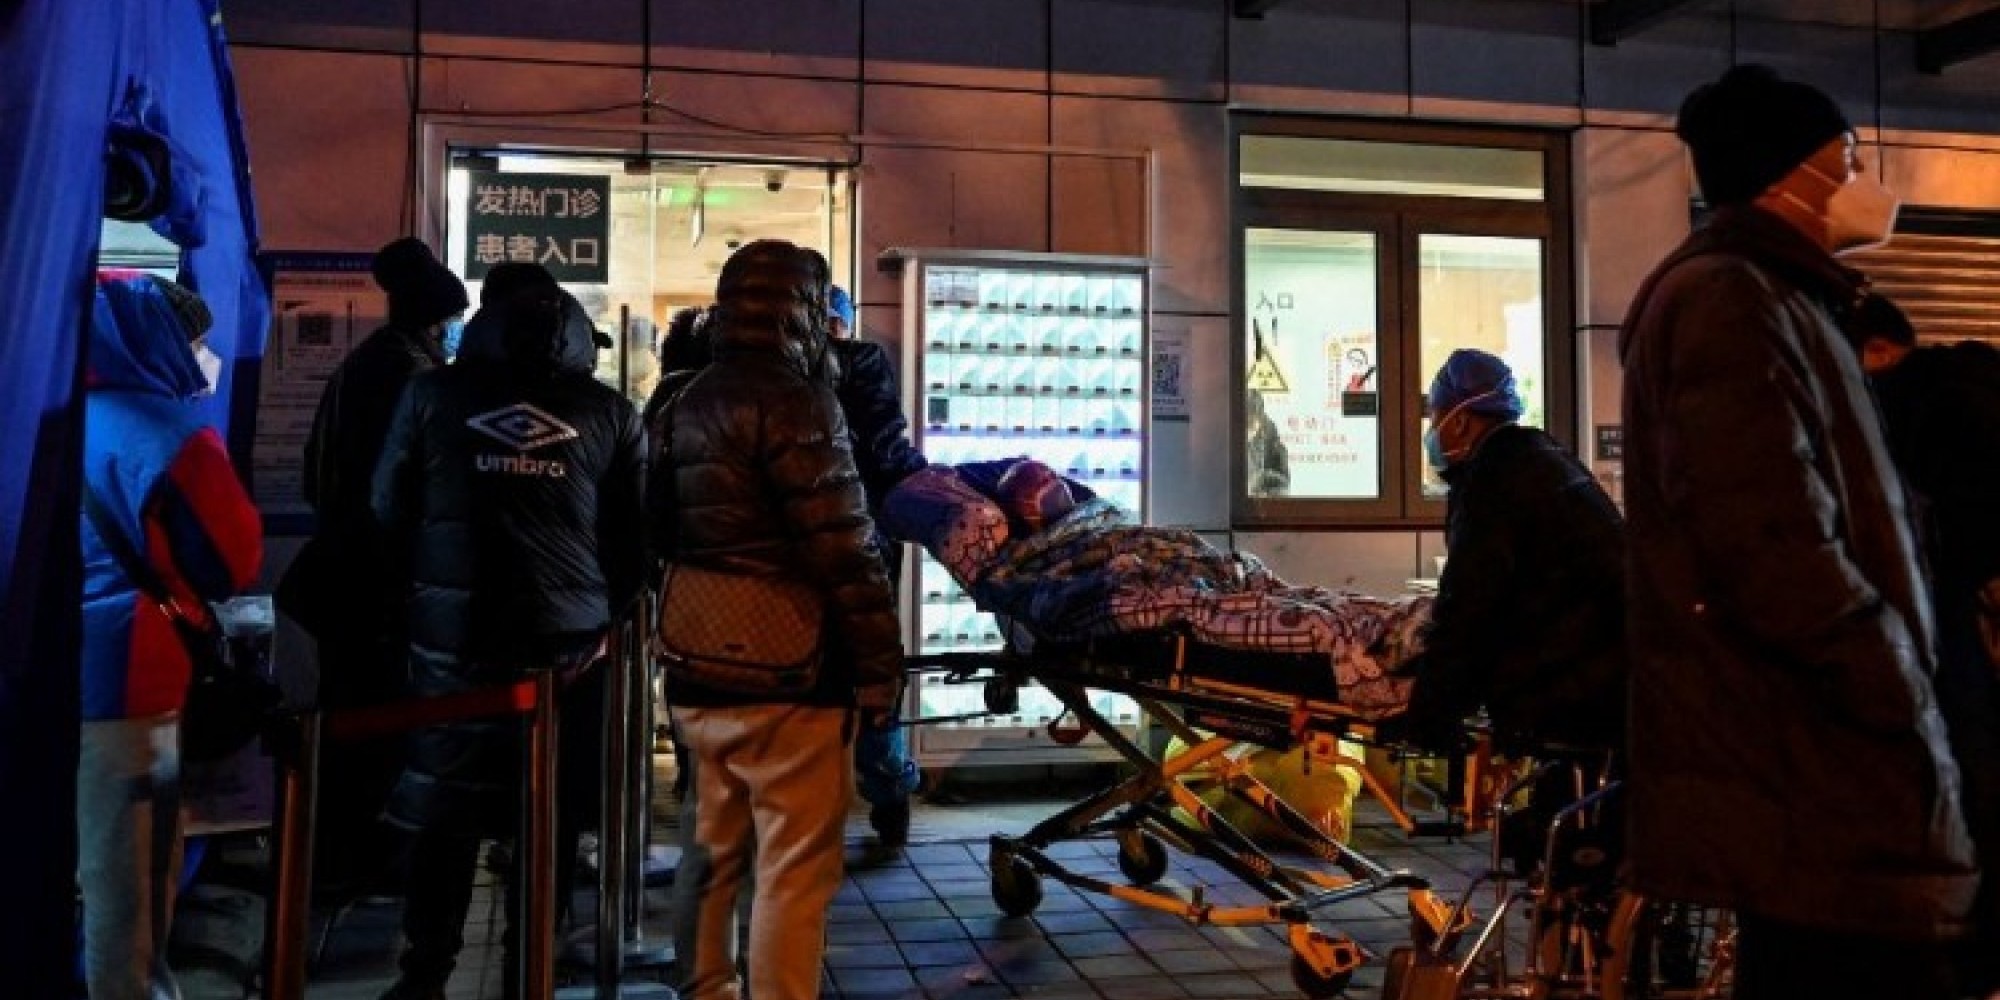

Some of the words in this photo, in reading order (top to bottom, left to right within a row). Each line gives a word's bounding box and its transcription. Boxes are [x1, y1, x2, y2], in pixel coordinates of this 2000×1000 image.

[475, 186, 600, 217] 发热门诊
[474, 234, 599, 264] 患者入口
[1255, 290, 1294, 312] 入口
[476, 454, 566, 478] umbro
